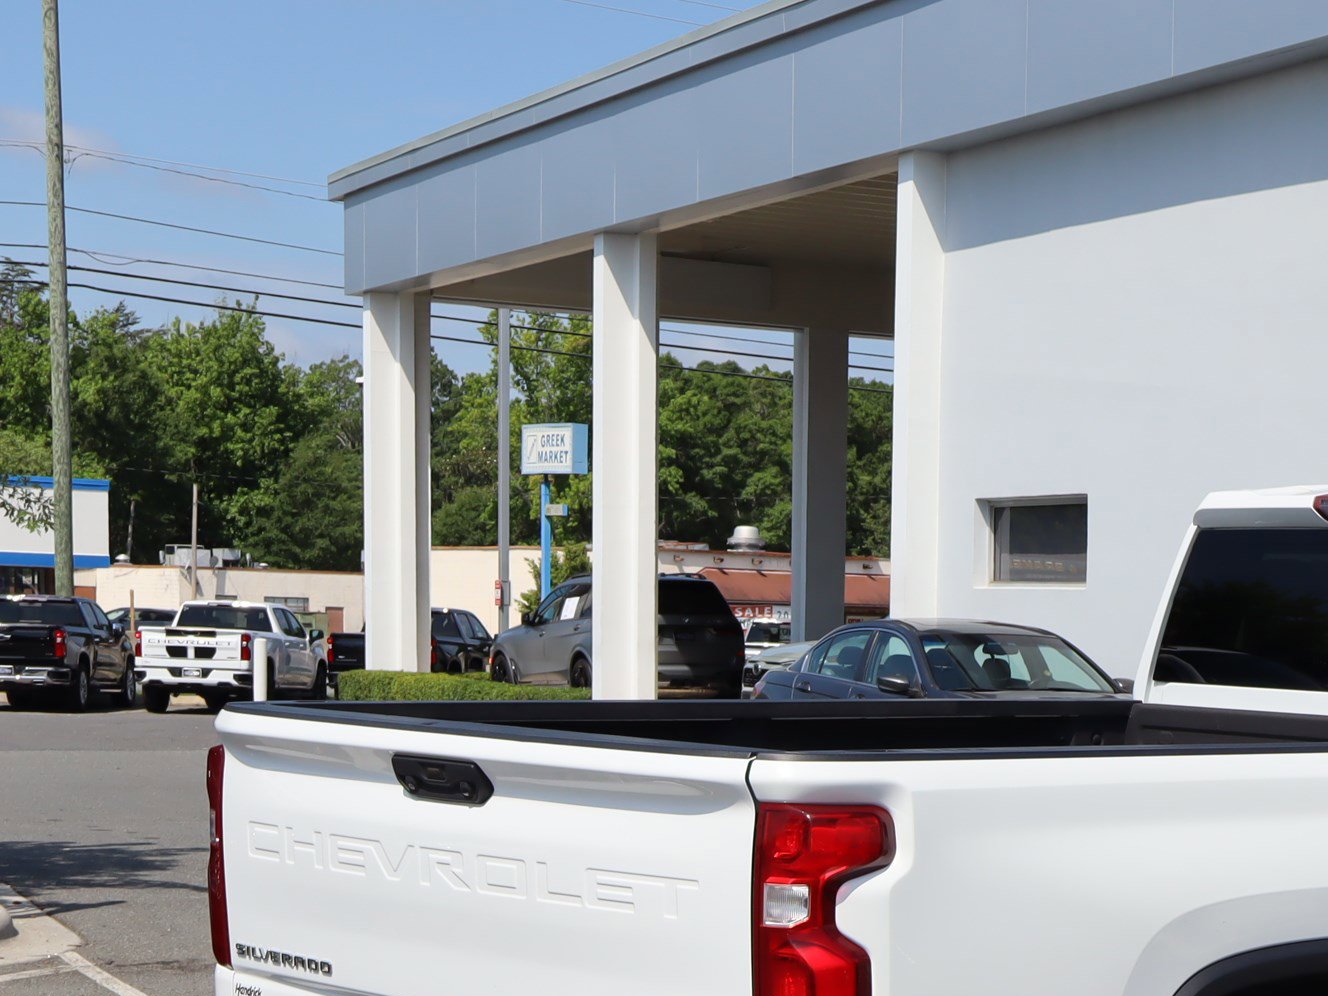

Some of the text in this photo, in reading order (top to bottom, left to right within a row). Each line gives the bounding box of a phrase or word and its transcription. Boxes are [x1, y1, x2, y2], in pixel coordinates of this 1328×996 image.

[540, 433, 566, 448] GREEK
[537, 450, 569, 464] MARKET
[734, 606, 772, 618] SALE
[148, 638, 232, 646] CHEVROLET
[248, 820, 700, 919] CHEVROLET
[235, 942, 333, 976] SILVERADO
